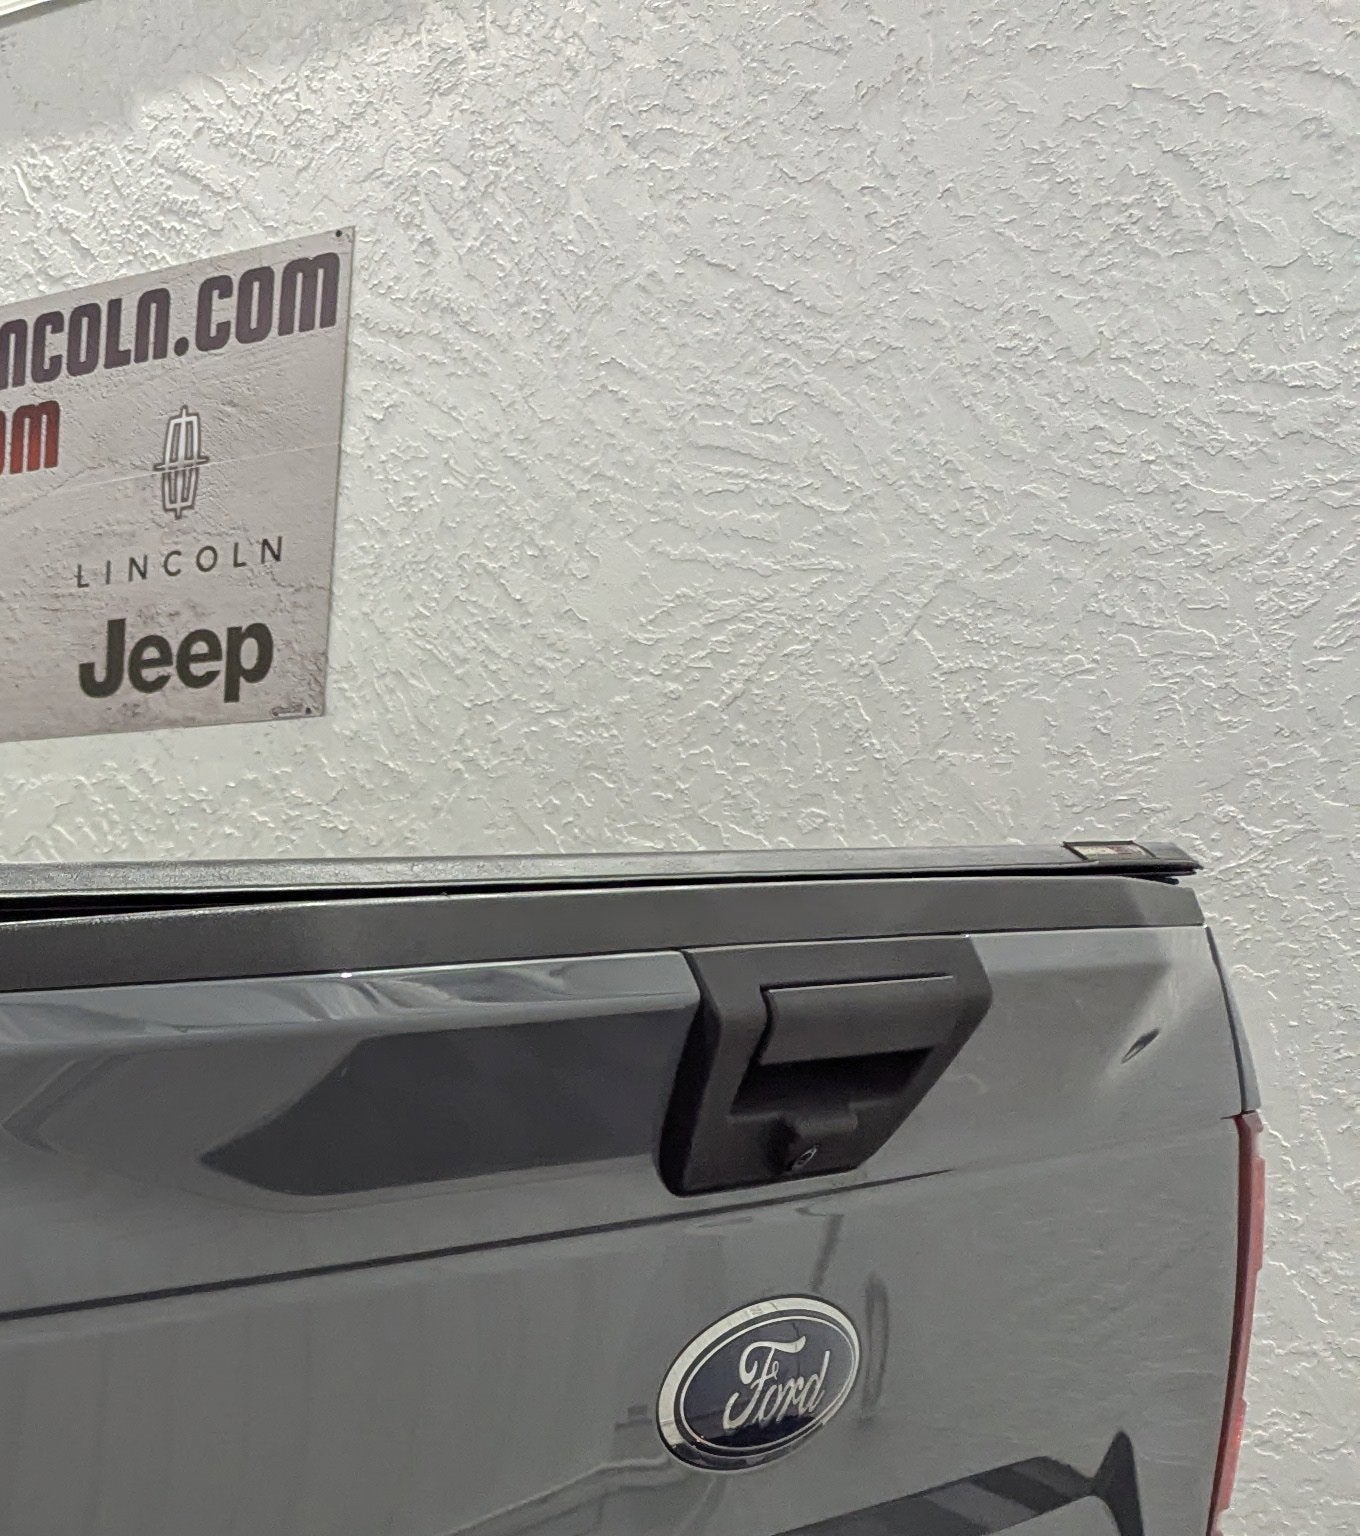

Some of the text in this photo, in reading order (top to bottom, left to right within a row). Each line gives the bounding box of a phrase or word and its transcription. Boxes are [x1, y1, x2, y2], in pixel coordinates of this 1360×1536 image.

[75, 536, 283, 589] LINCOLN
[78, 618, 274, 703] Jeep
[722, 1335, 831, 1431] Ford
